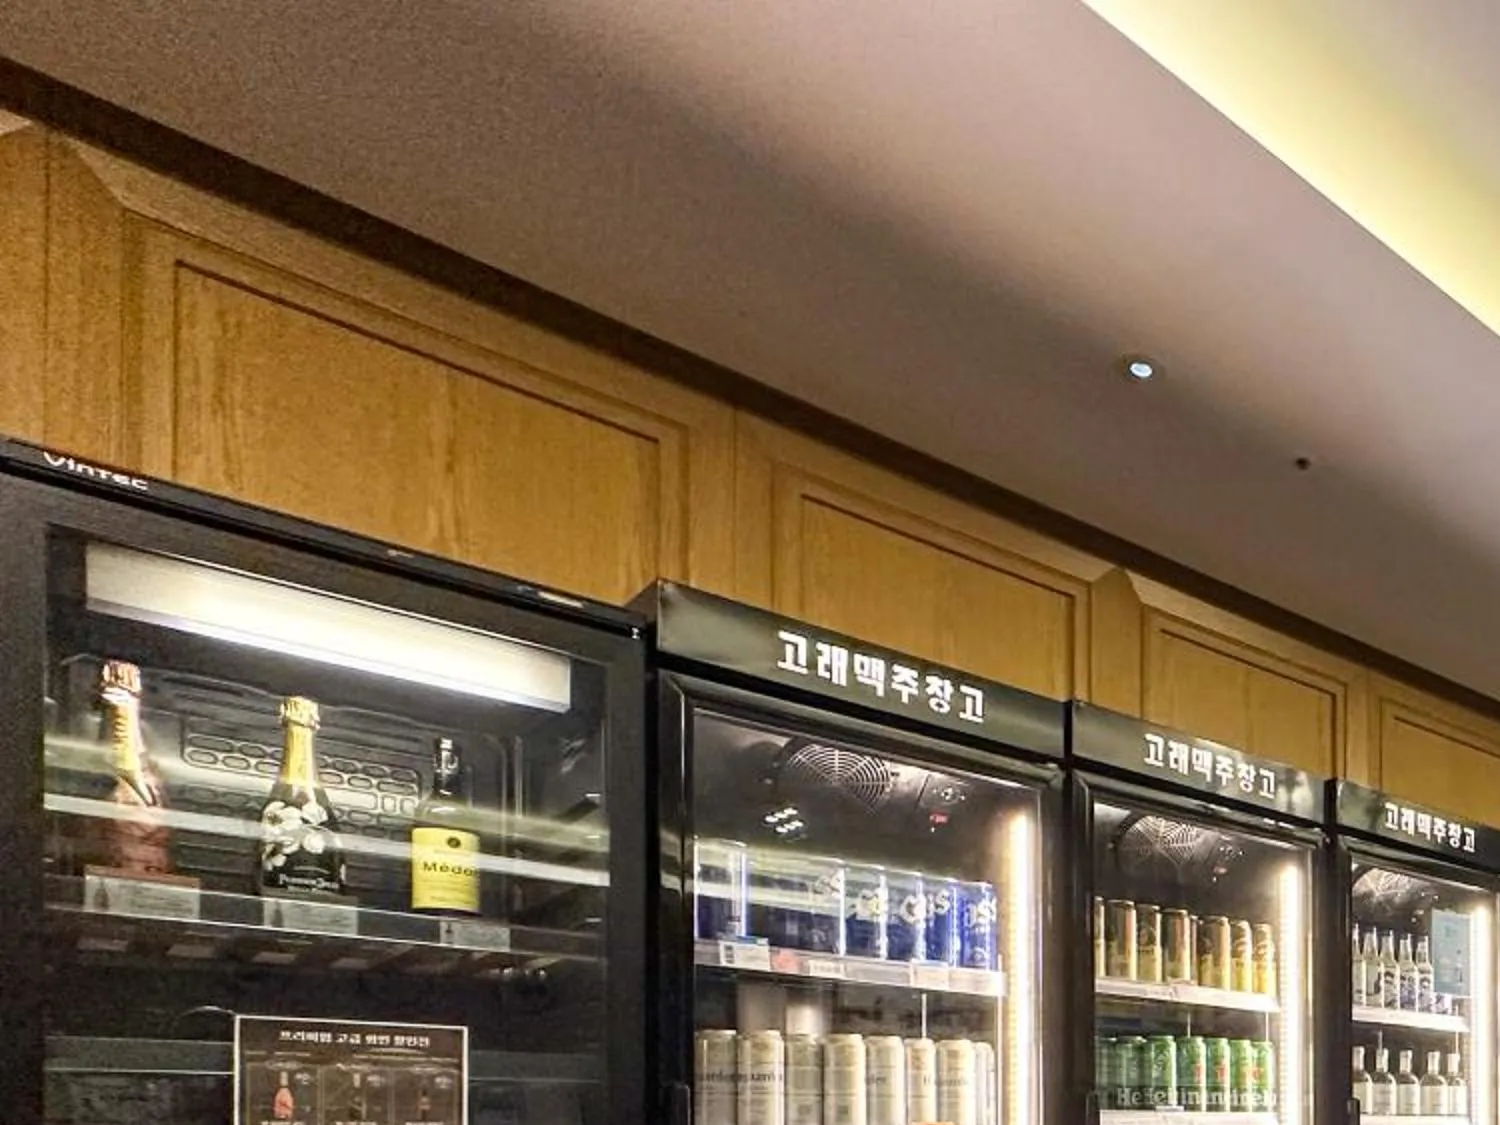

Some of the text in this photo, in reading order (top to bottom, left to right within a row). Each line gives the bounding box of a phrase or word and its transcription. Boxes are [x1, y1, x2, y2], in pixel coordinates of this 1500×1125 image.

[777, 630, 985, 724] 고래맥주창고
[1143, 733, 1276, 800] 고래맥주창고
[1384, 802, 1476, 853] 고래맥주창고
